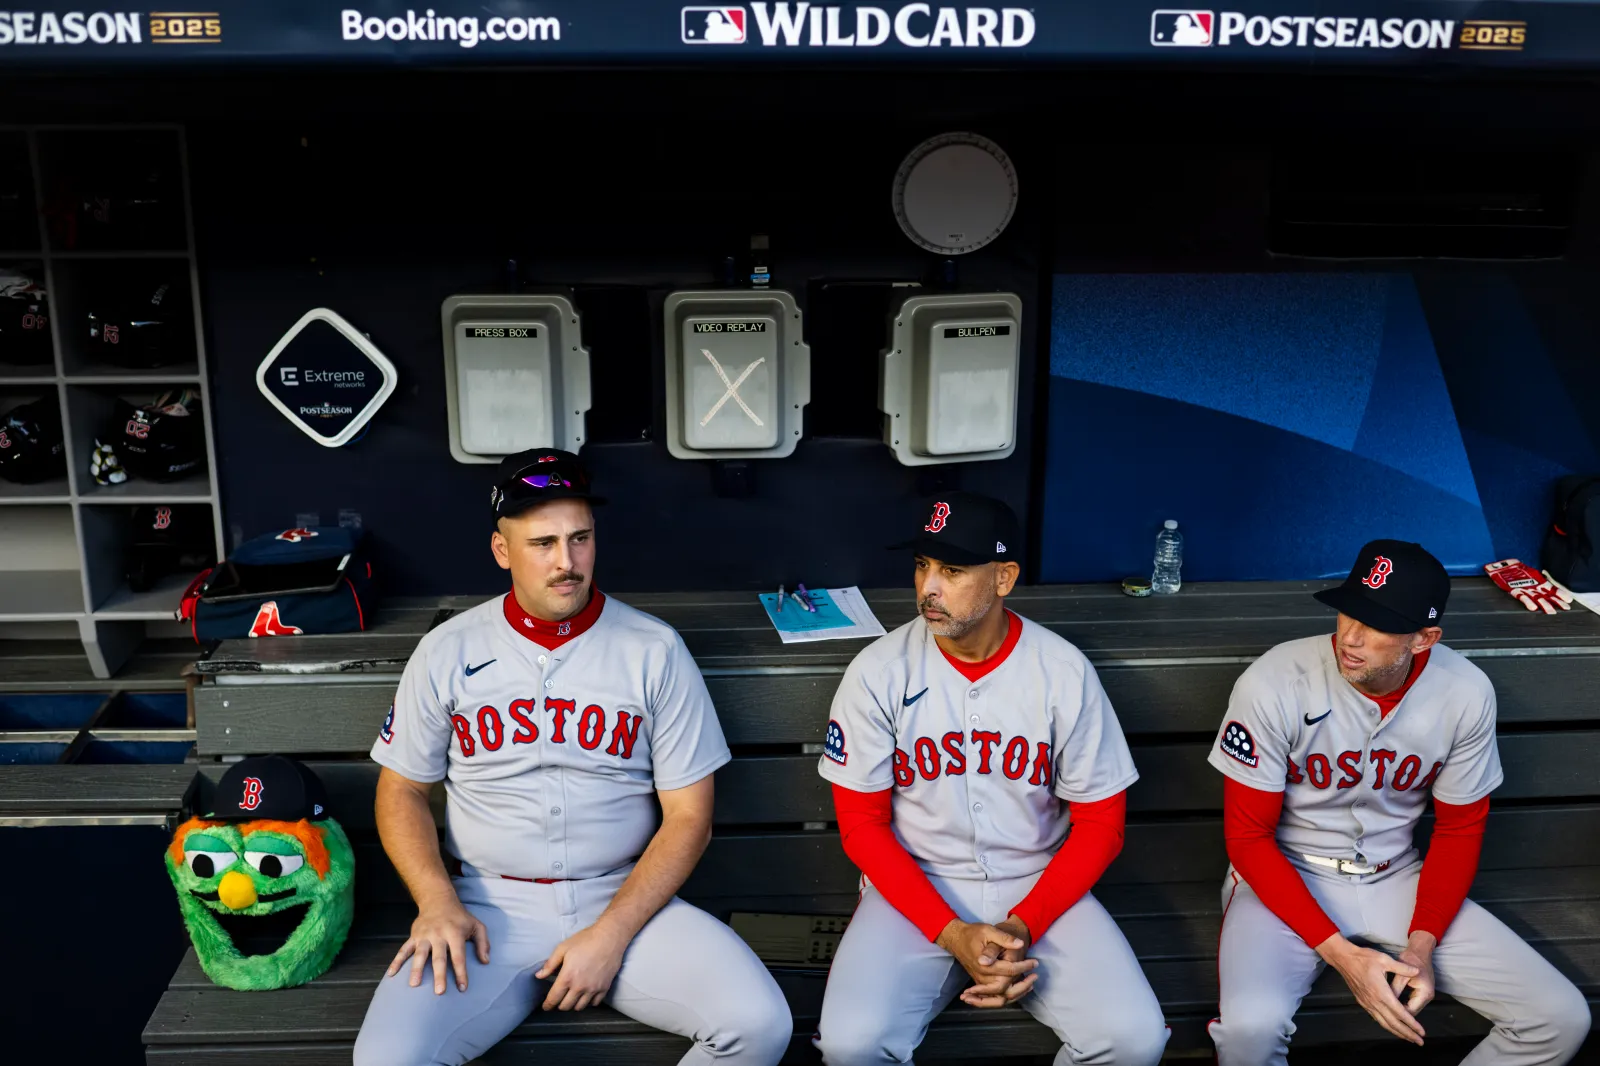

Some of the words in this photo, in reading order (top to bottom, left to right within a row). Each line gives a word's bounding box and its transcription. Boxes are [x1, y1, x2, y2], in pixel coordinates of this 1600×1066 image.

[0, 12, 142, 44] SEASON
[150, 19, 221, 36] 2025
[341, 8, 561, 48] Booking.com
[1218, 12, 1455, 49] POSTSEASON
[1460, 27, 1526, 44] 2025
[475, 328, 505, 337] PRESS
[509, 328, 528, 337] BOX
[696, 323, 723, 332] VIDEO
[727, 323, 763, 332] REPLAY
[958, 327, 996, 337] BULLPEN
[304, 369, 365, 382] Extreme
[334, 381, 365, 389] networks
[300, 406, 353, 415] POSTSEASON
[152, 505, 172, 530] B
[924, 501, 951, 533] B
[1361, 555, 1394, 589] B
[451, 696, 643, 760] BOSTON
[238, 777, 264, 811] B
